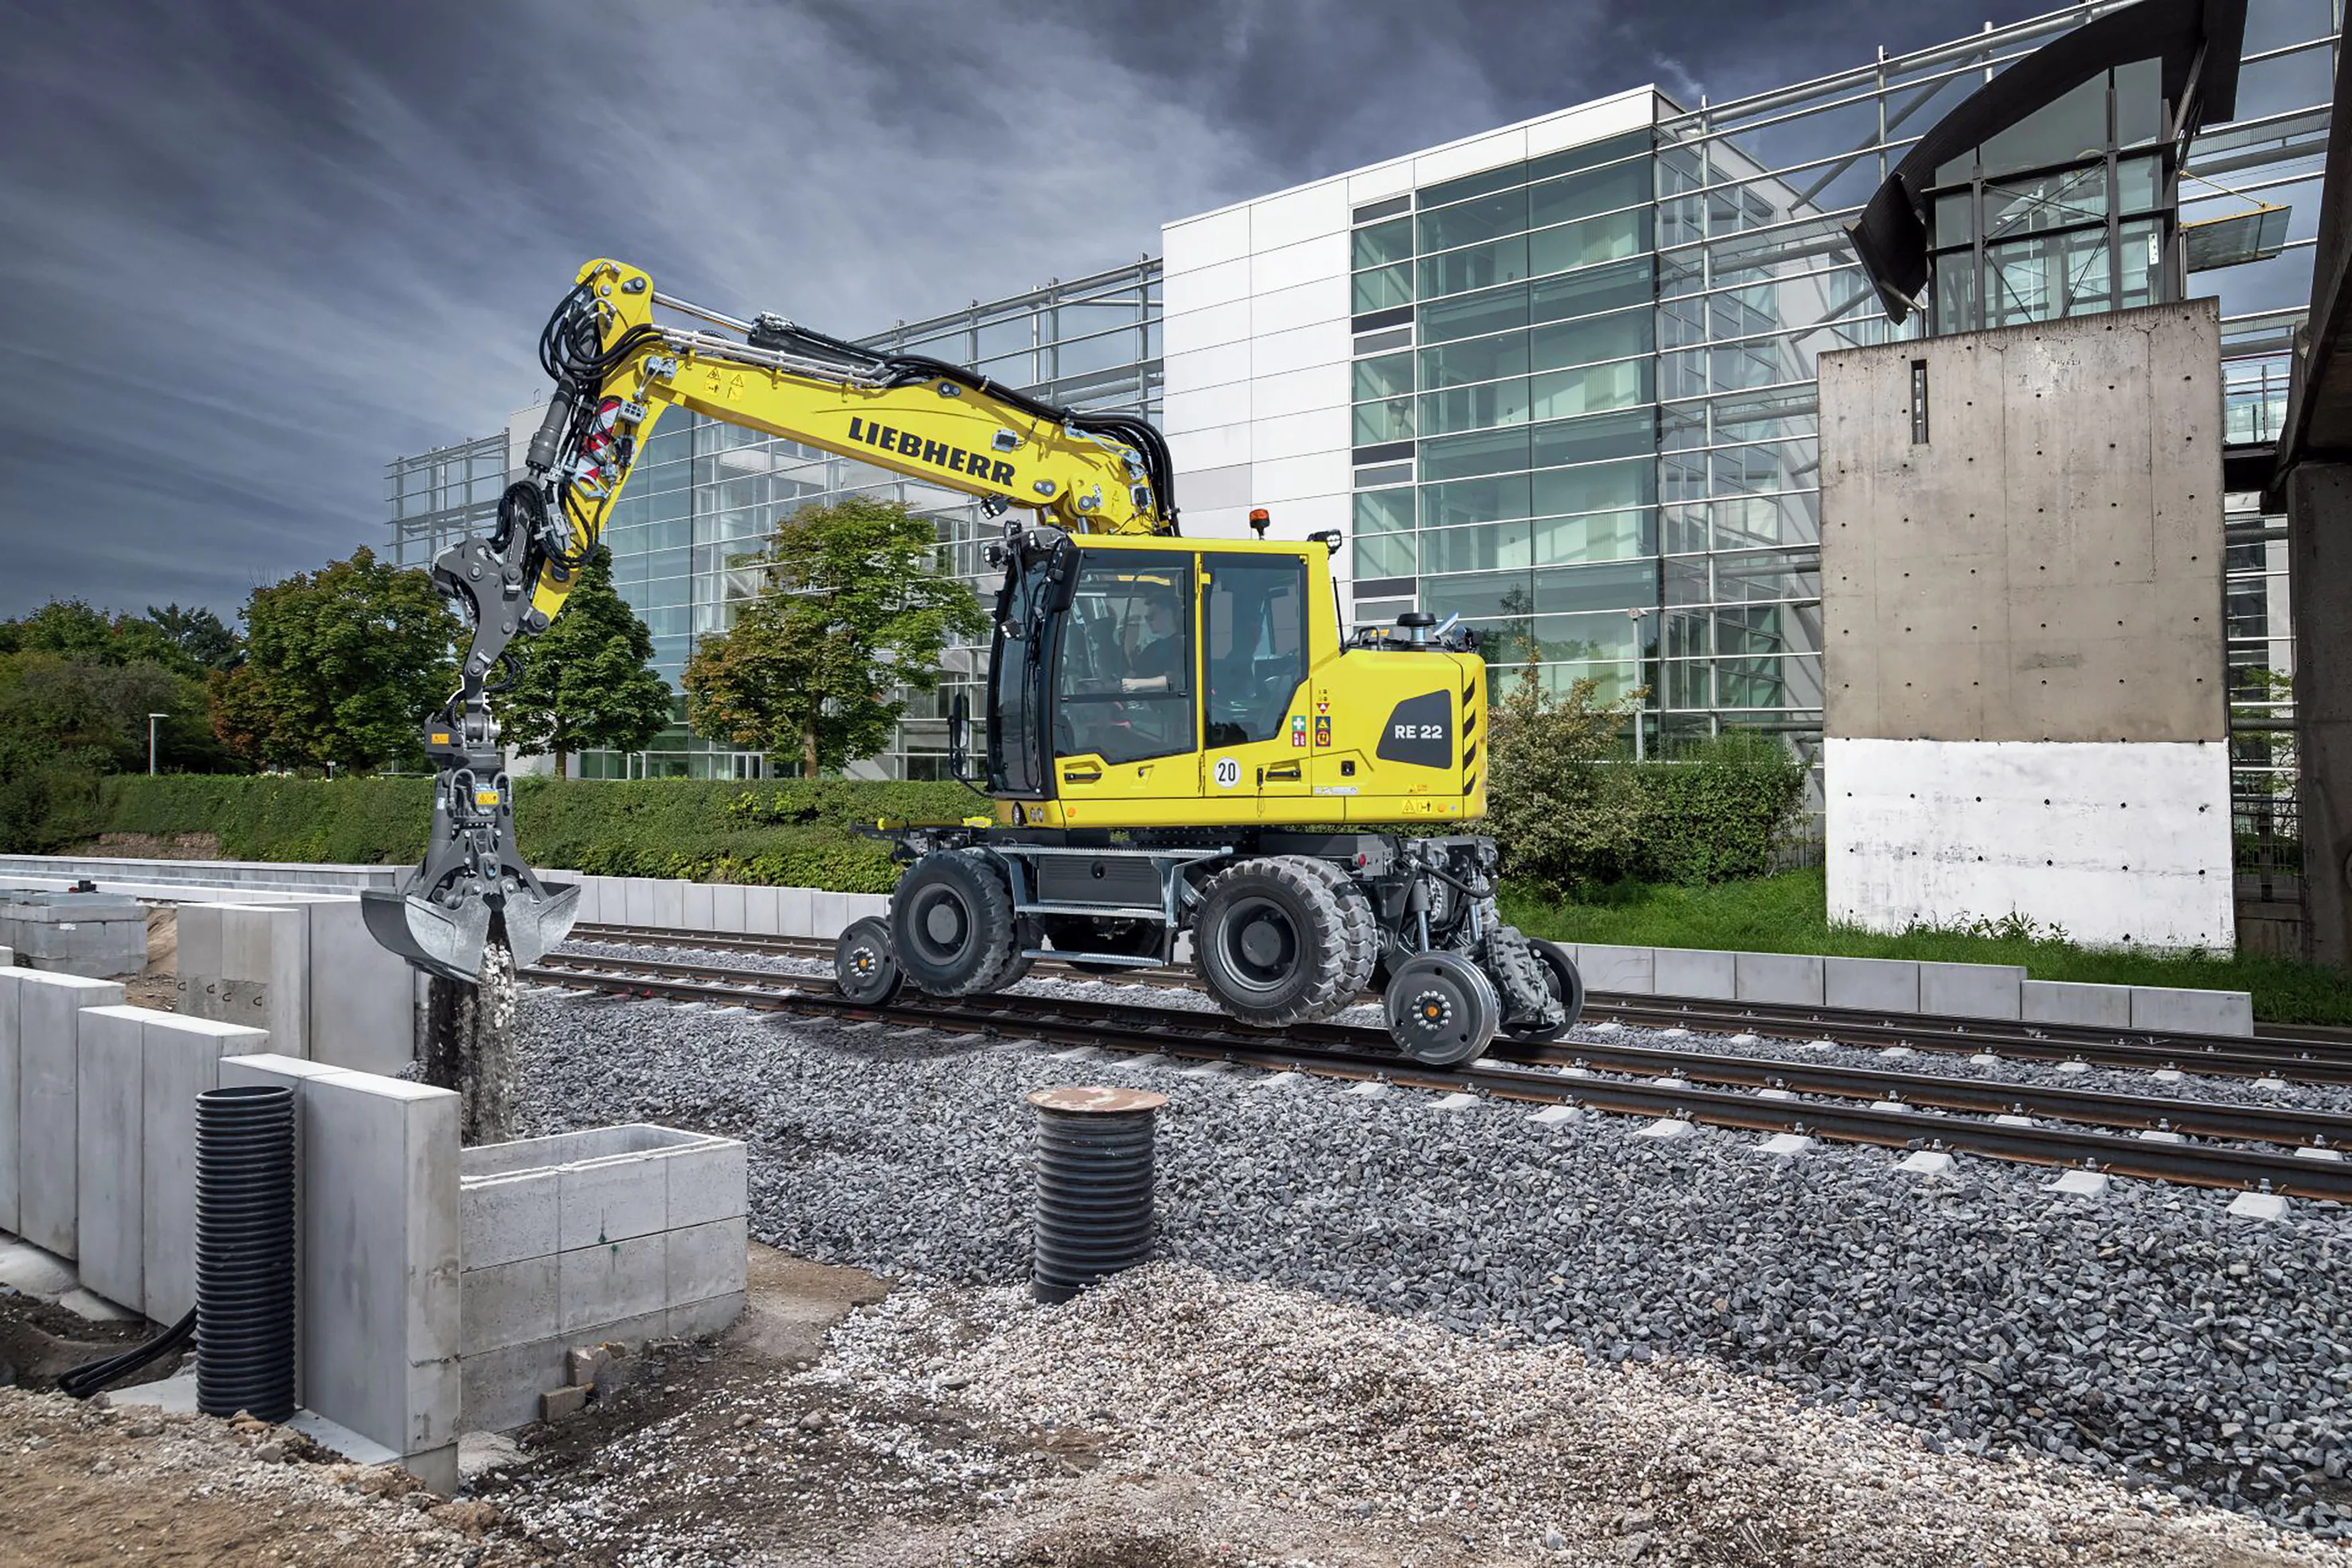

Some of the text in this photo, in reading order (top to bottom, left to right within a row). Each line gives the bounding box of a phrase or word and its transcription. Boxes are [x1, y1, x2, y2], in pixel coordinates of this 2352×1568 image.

[848, 416, 1016, 487] LIEBHERR
[1395, 725, 1442, 739] RE 22
[1219, 762, 1235, 781] 20
